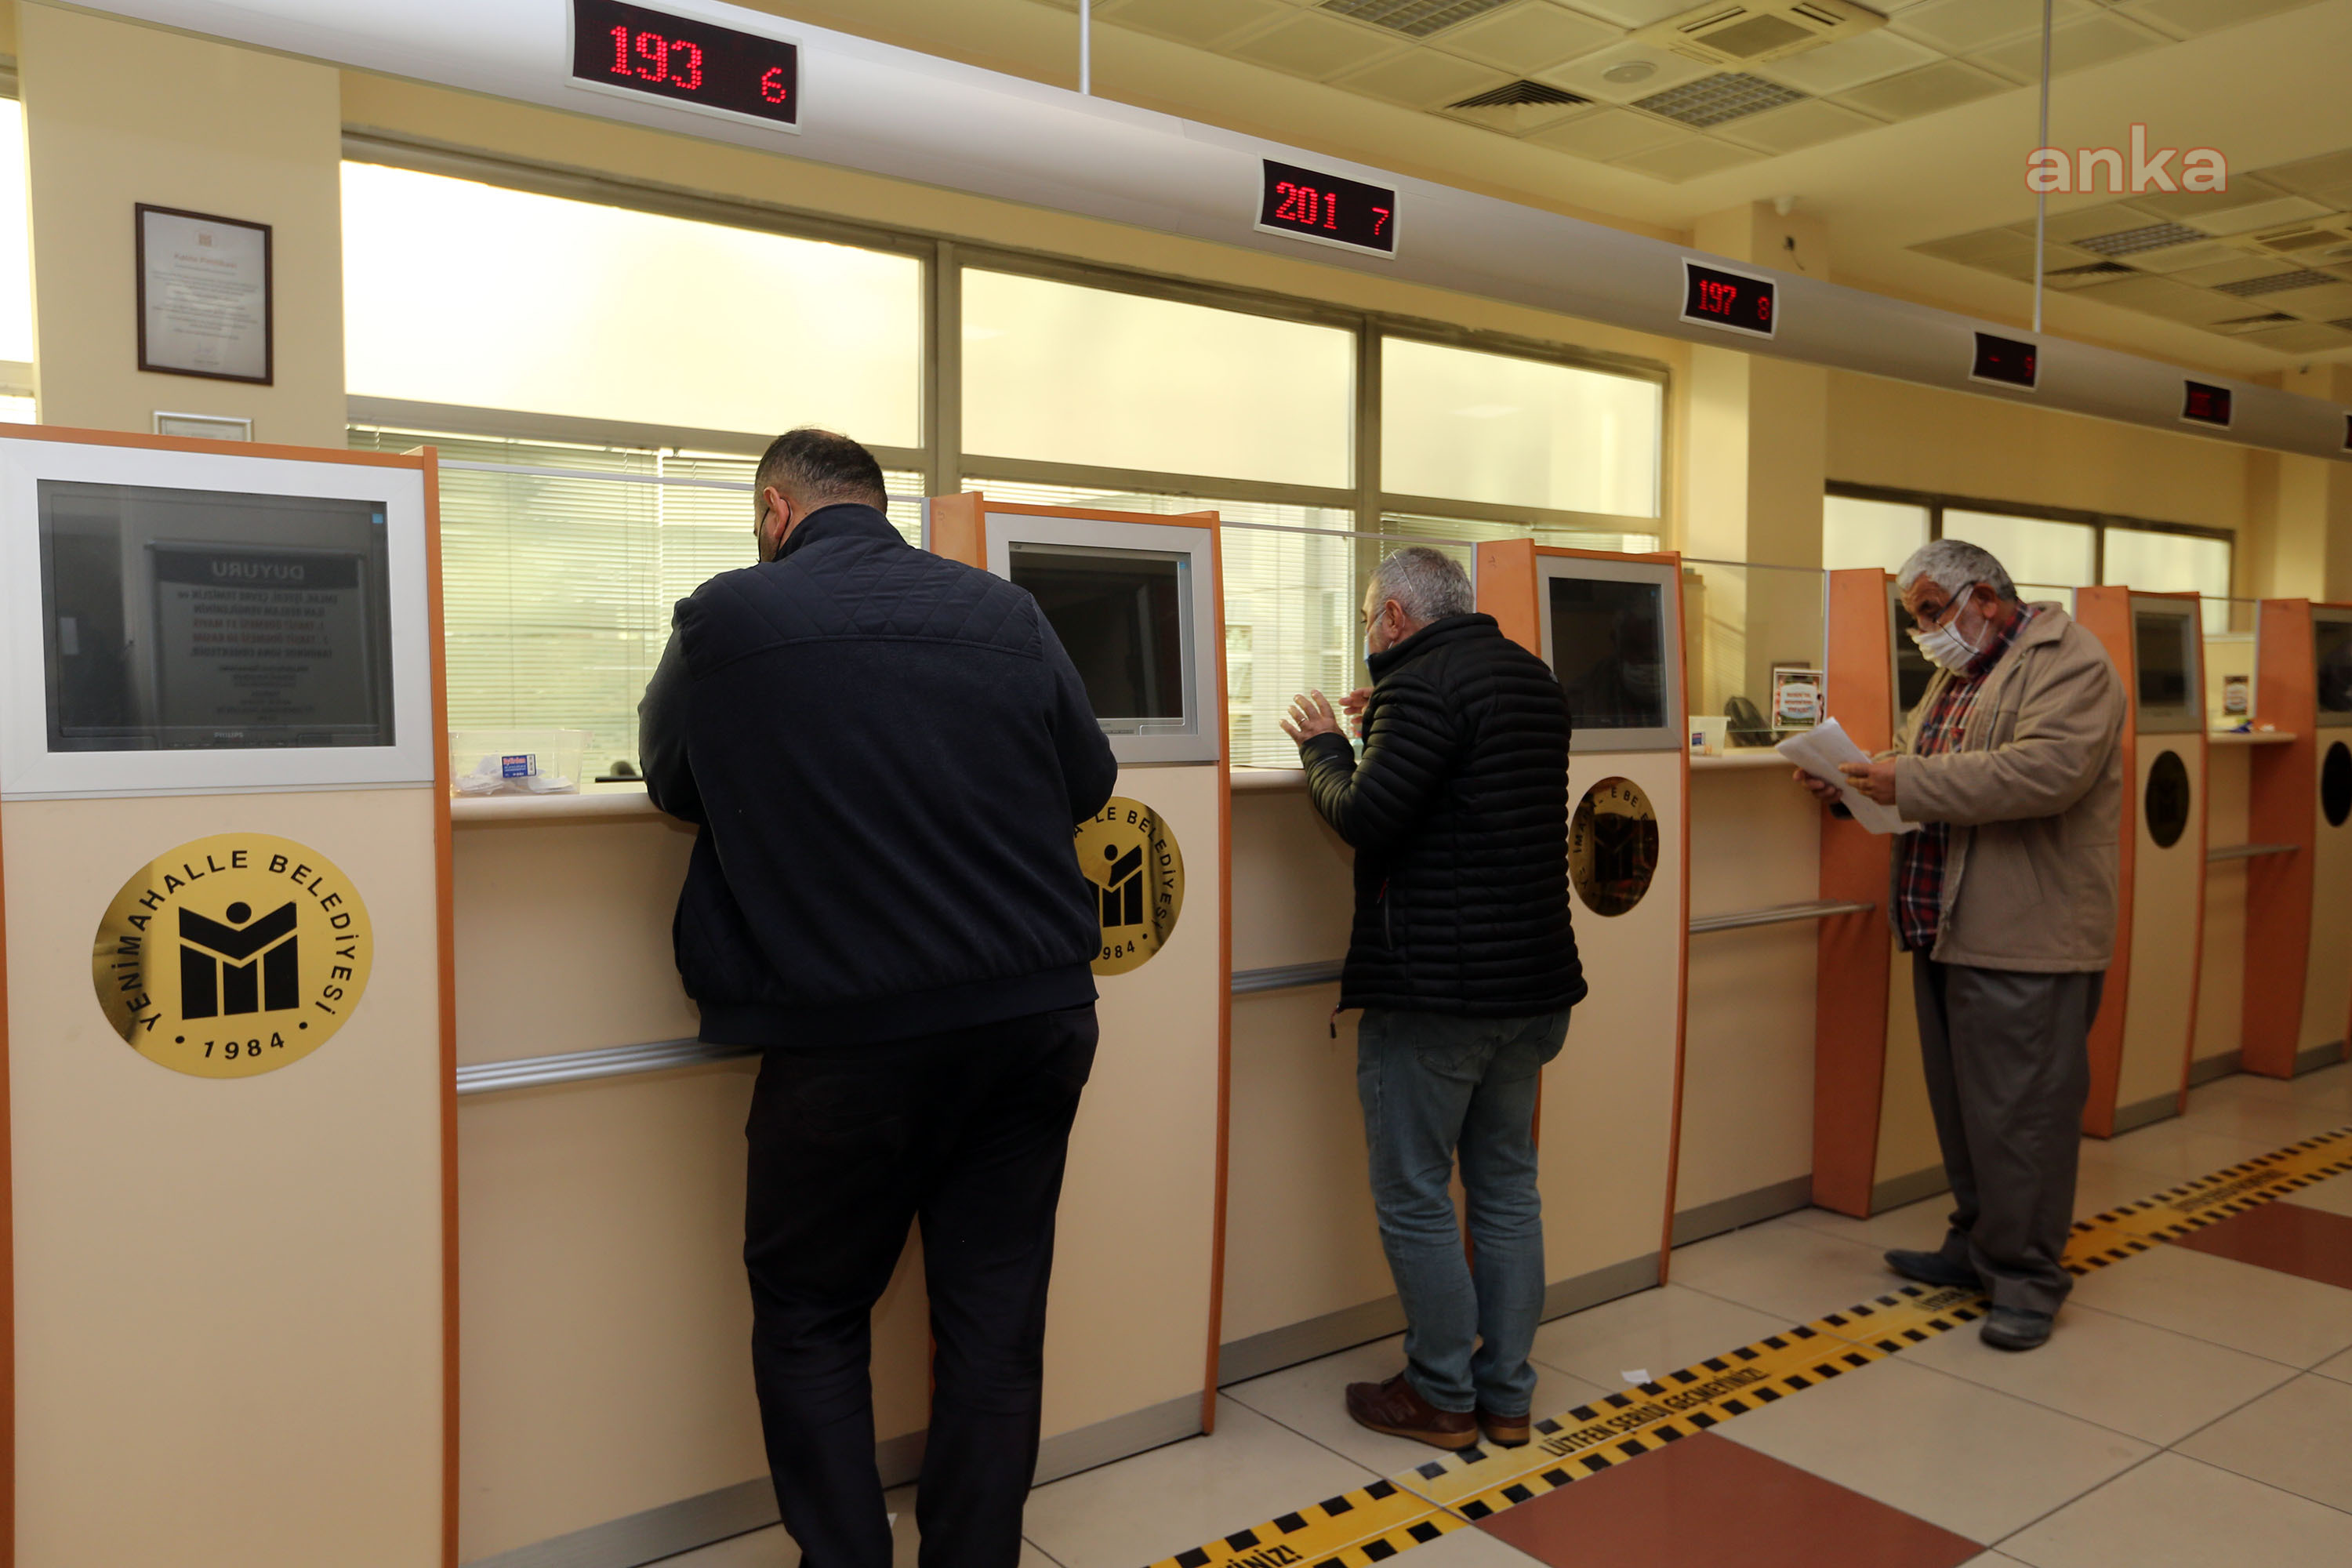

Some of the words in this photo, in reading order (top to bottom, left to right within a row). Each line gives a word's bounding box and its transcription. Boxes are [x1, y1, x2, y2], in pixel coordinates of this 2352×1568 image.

[610, 25, 702, 90] 193
[761, 67, 787, 103] 6
[1276, 181, 1338, 230] 201
[1372, 207, 1390, 235] 7
[1697, 279, 1738, 316] 197
[1757, 296, 1770, 321] 8
[111, 851, 249, 1032] YENİMAHALLE
[268, 854, 360, 1015] BELEDİYESİ
[1102, 940, 1135, 960] 984
[203, 1032, 285, 1060] 1984
[1537, 1423, 1619, 1457] LÜTFEN
